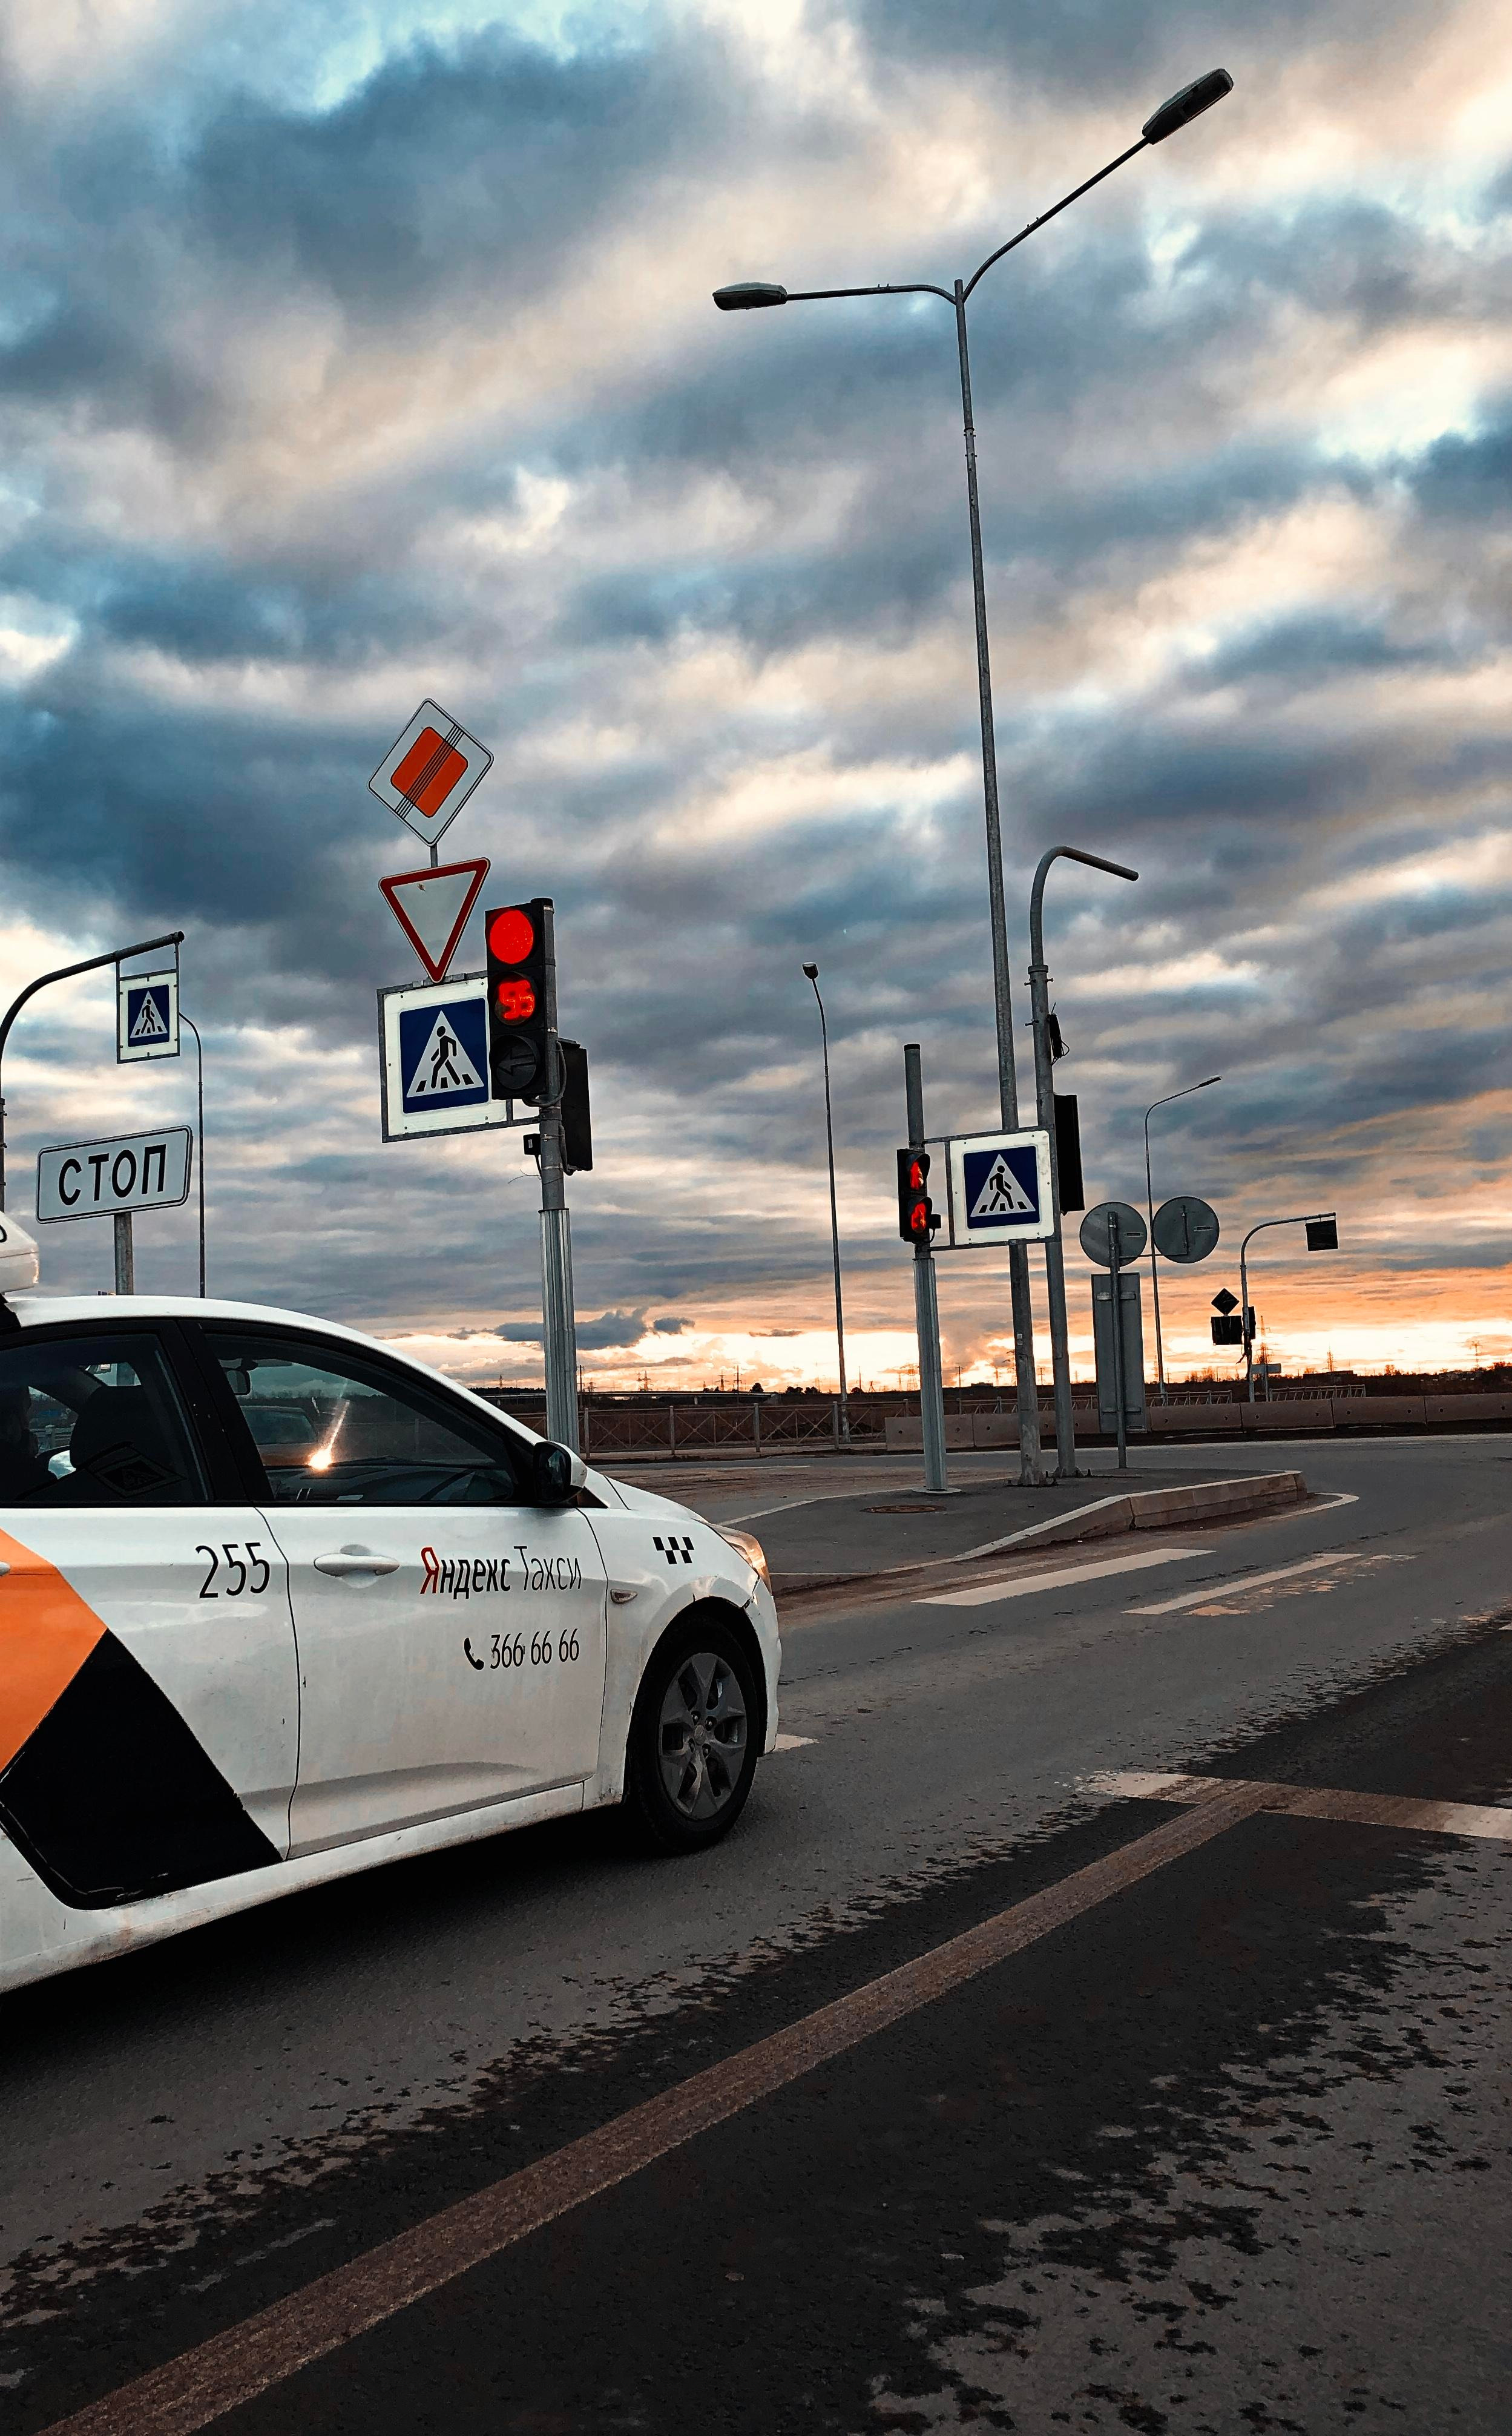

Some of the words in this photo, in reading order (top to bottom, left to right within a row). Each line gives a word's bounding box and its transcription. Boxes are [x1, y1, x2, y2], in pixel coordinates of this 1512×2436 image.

[59, 1144, 166, 1205] СТОП
[195, 1542, 270, 1599] 255
[419, 1547, 511, 1599] Яндекс
[513, 1546, 582, 1591] Такси
[490, 1633, 524, 1670] 366
[530, 1630, 552, 1665] 66
[559, 1628, 579, 1662] 66
